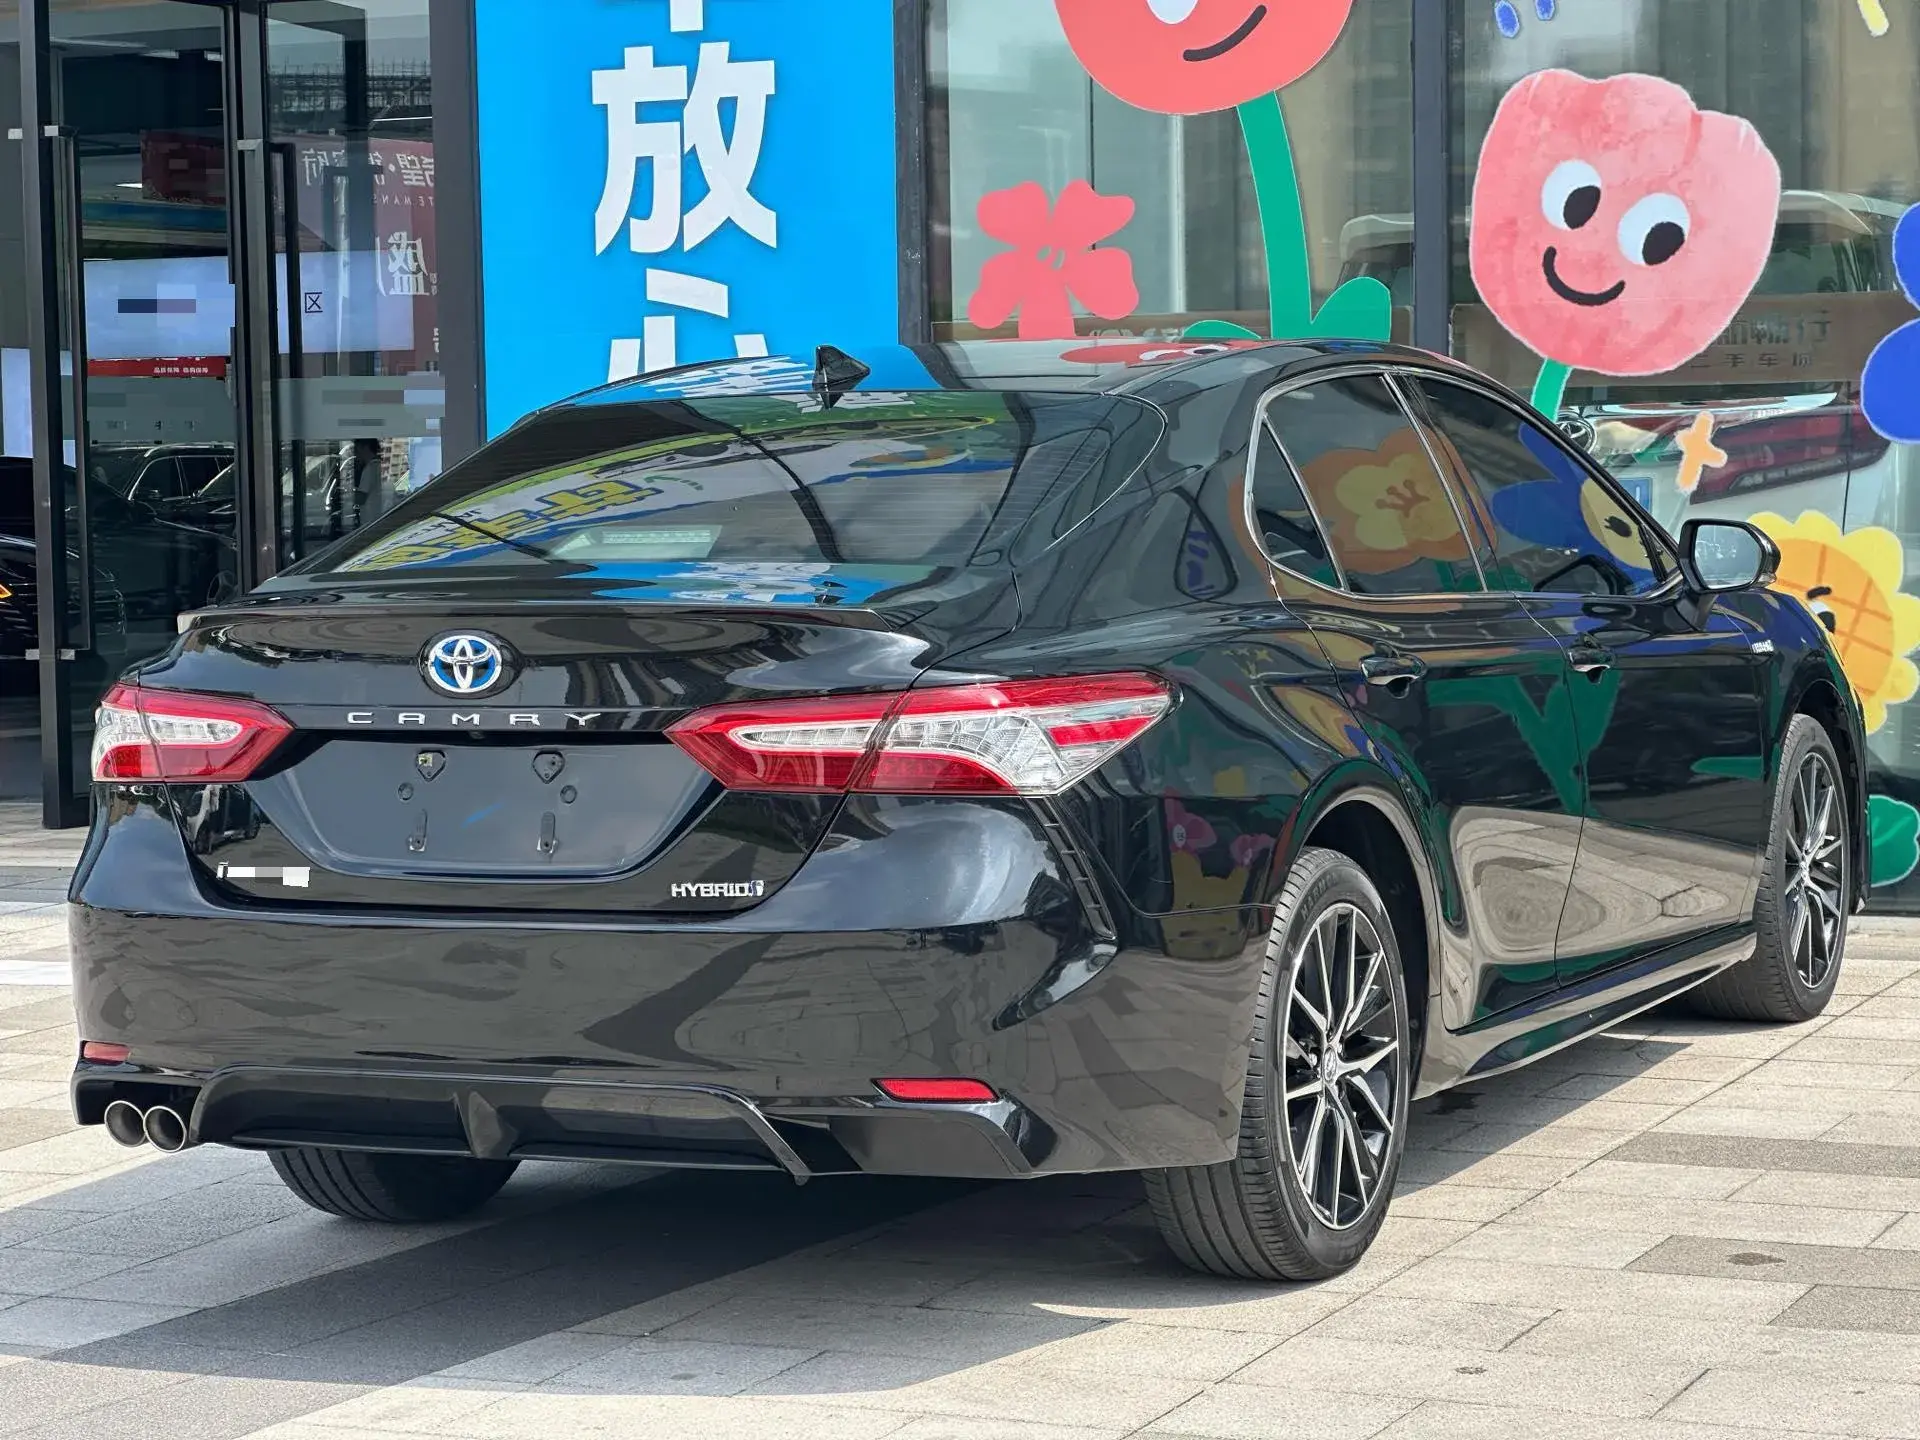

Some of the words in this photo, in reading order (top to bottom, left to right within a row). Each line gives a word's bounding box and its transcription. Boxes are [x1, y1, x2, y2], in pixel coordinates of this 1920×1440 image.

[592, 0, 777, 382] 放心
[347, 711, 601, 727] CAMRY
[671, 882, 750, 898] HYBRID
